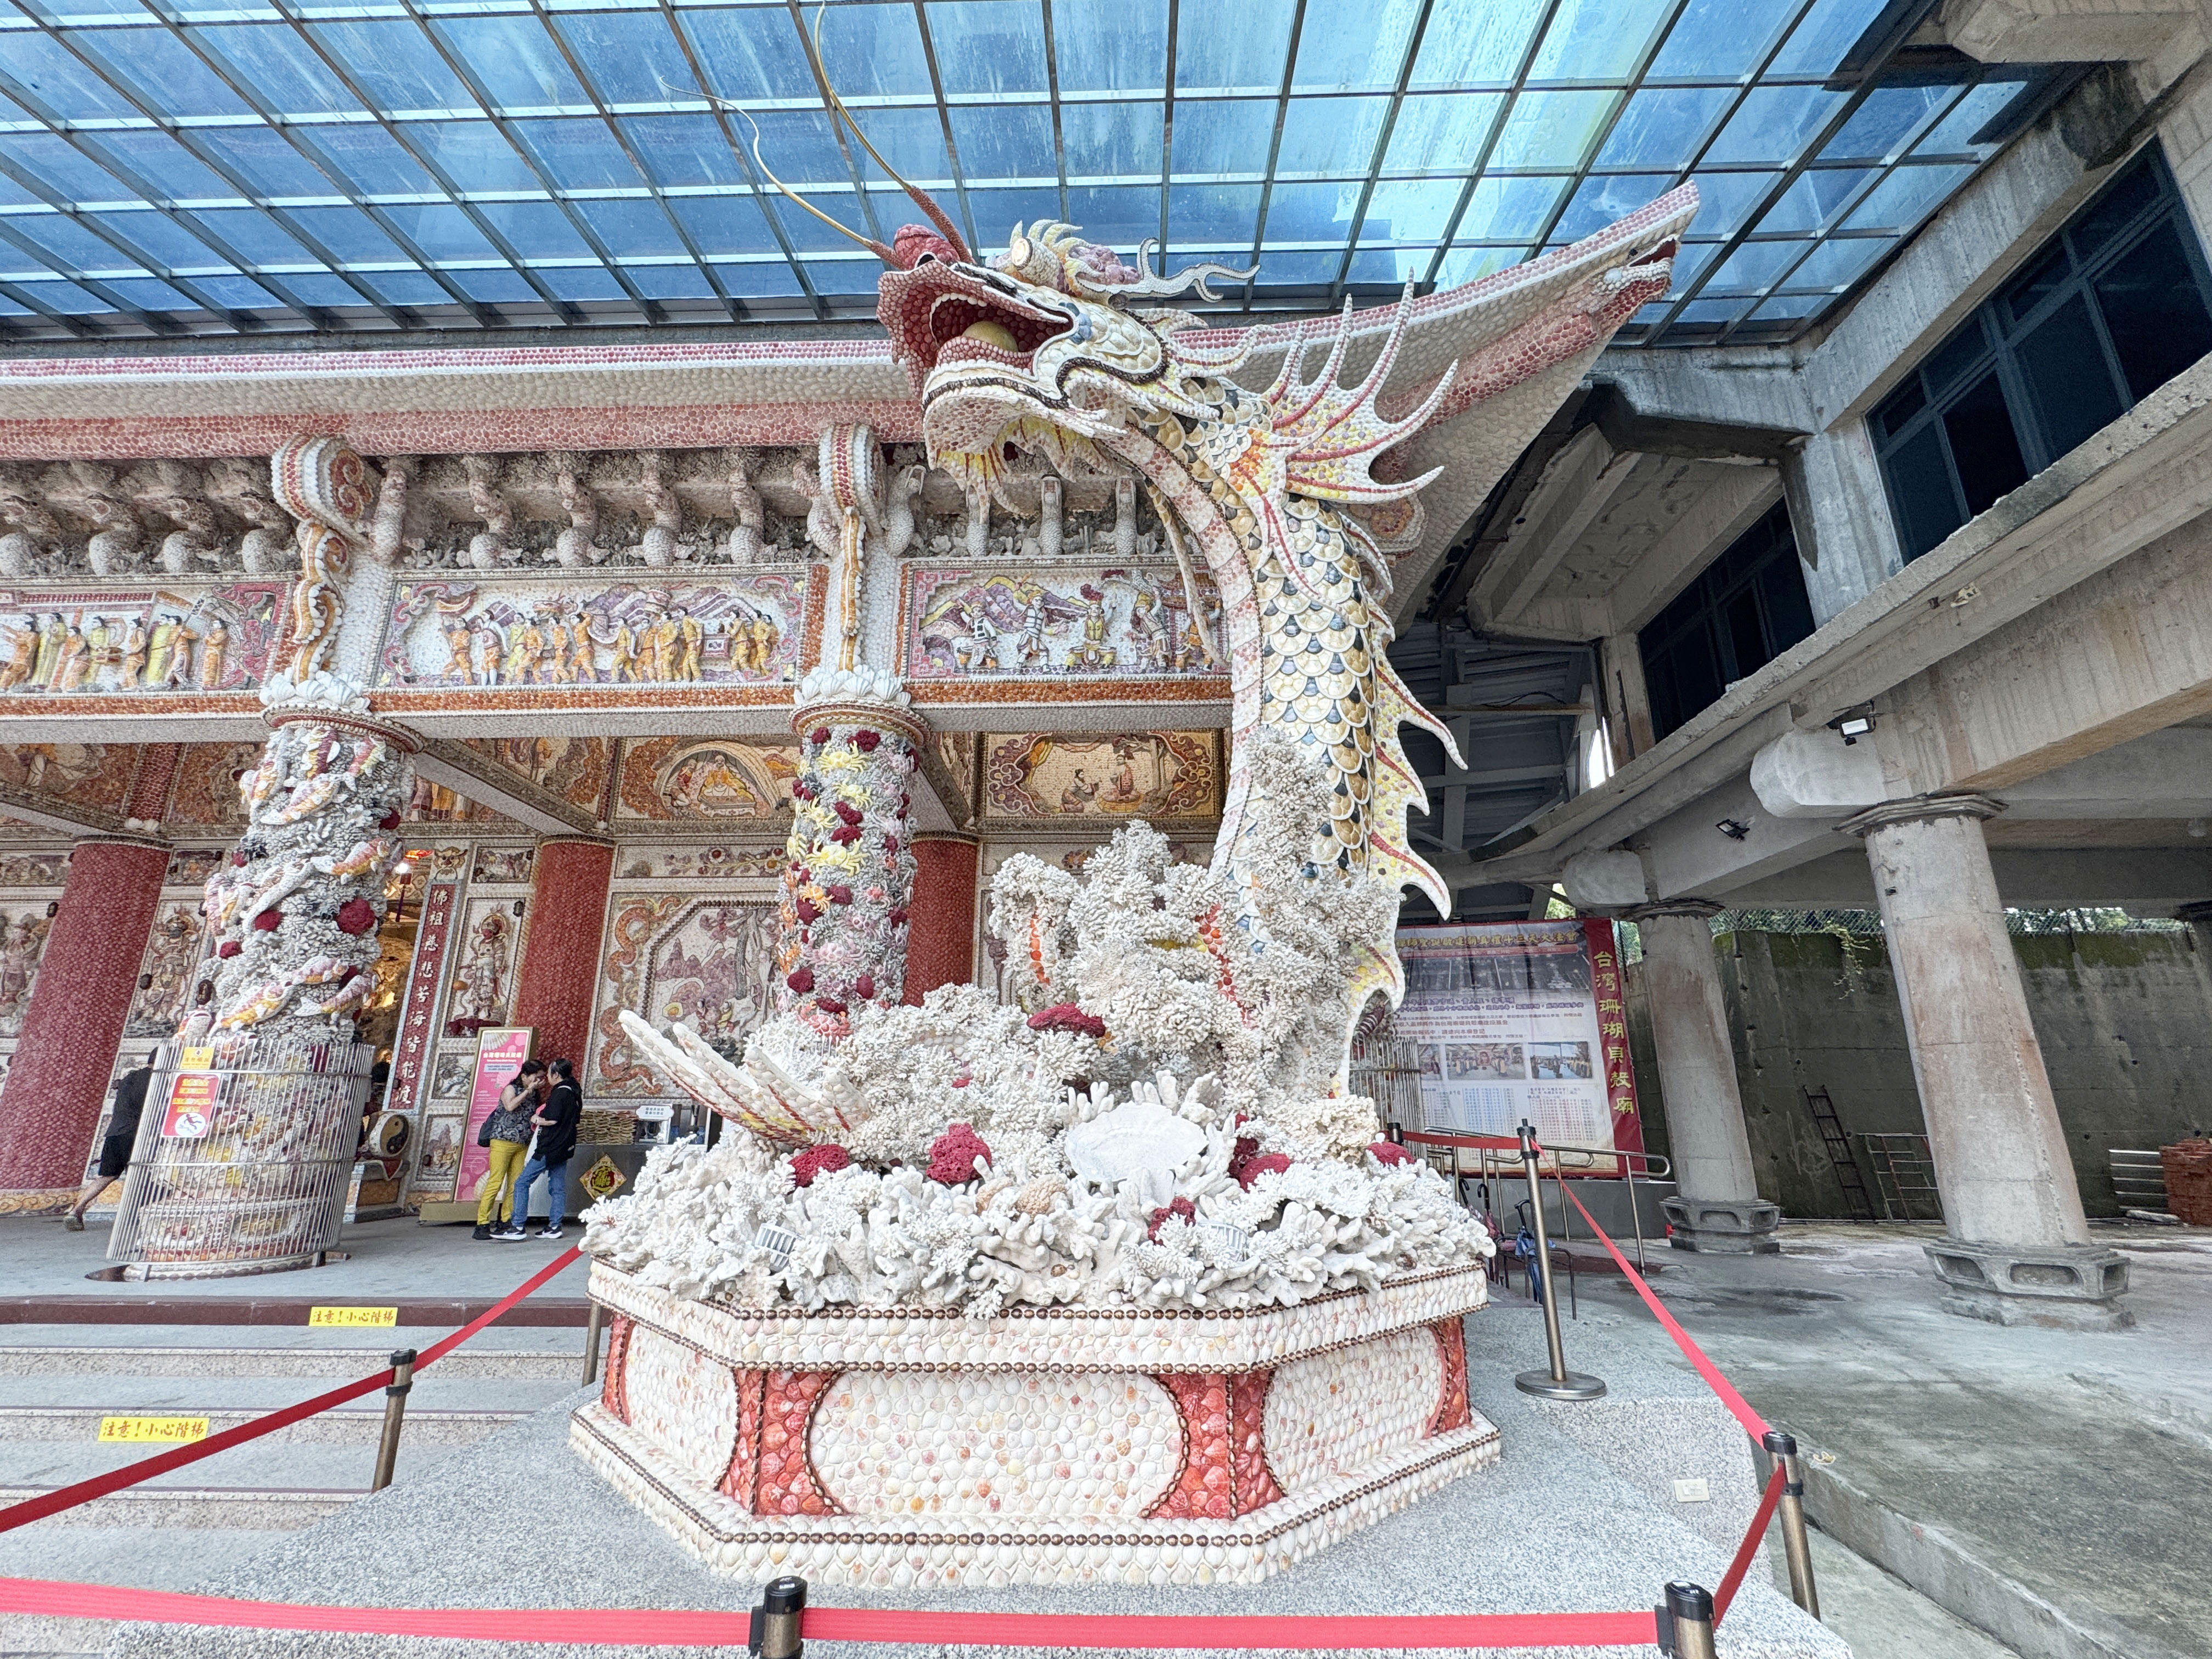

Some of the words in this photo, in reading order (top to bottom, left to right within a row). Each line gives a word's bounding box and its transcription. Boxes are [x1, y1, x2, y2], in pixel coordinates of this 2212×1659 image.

[395, 889, 448, 1104] 佛祖慈悲苦海皆能渡
[1593, 950, 1634, 1115] 台灣珊瑚貝殼廟
